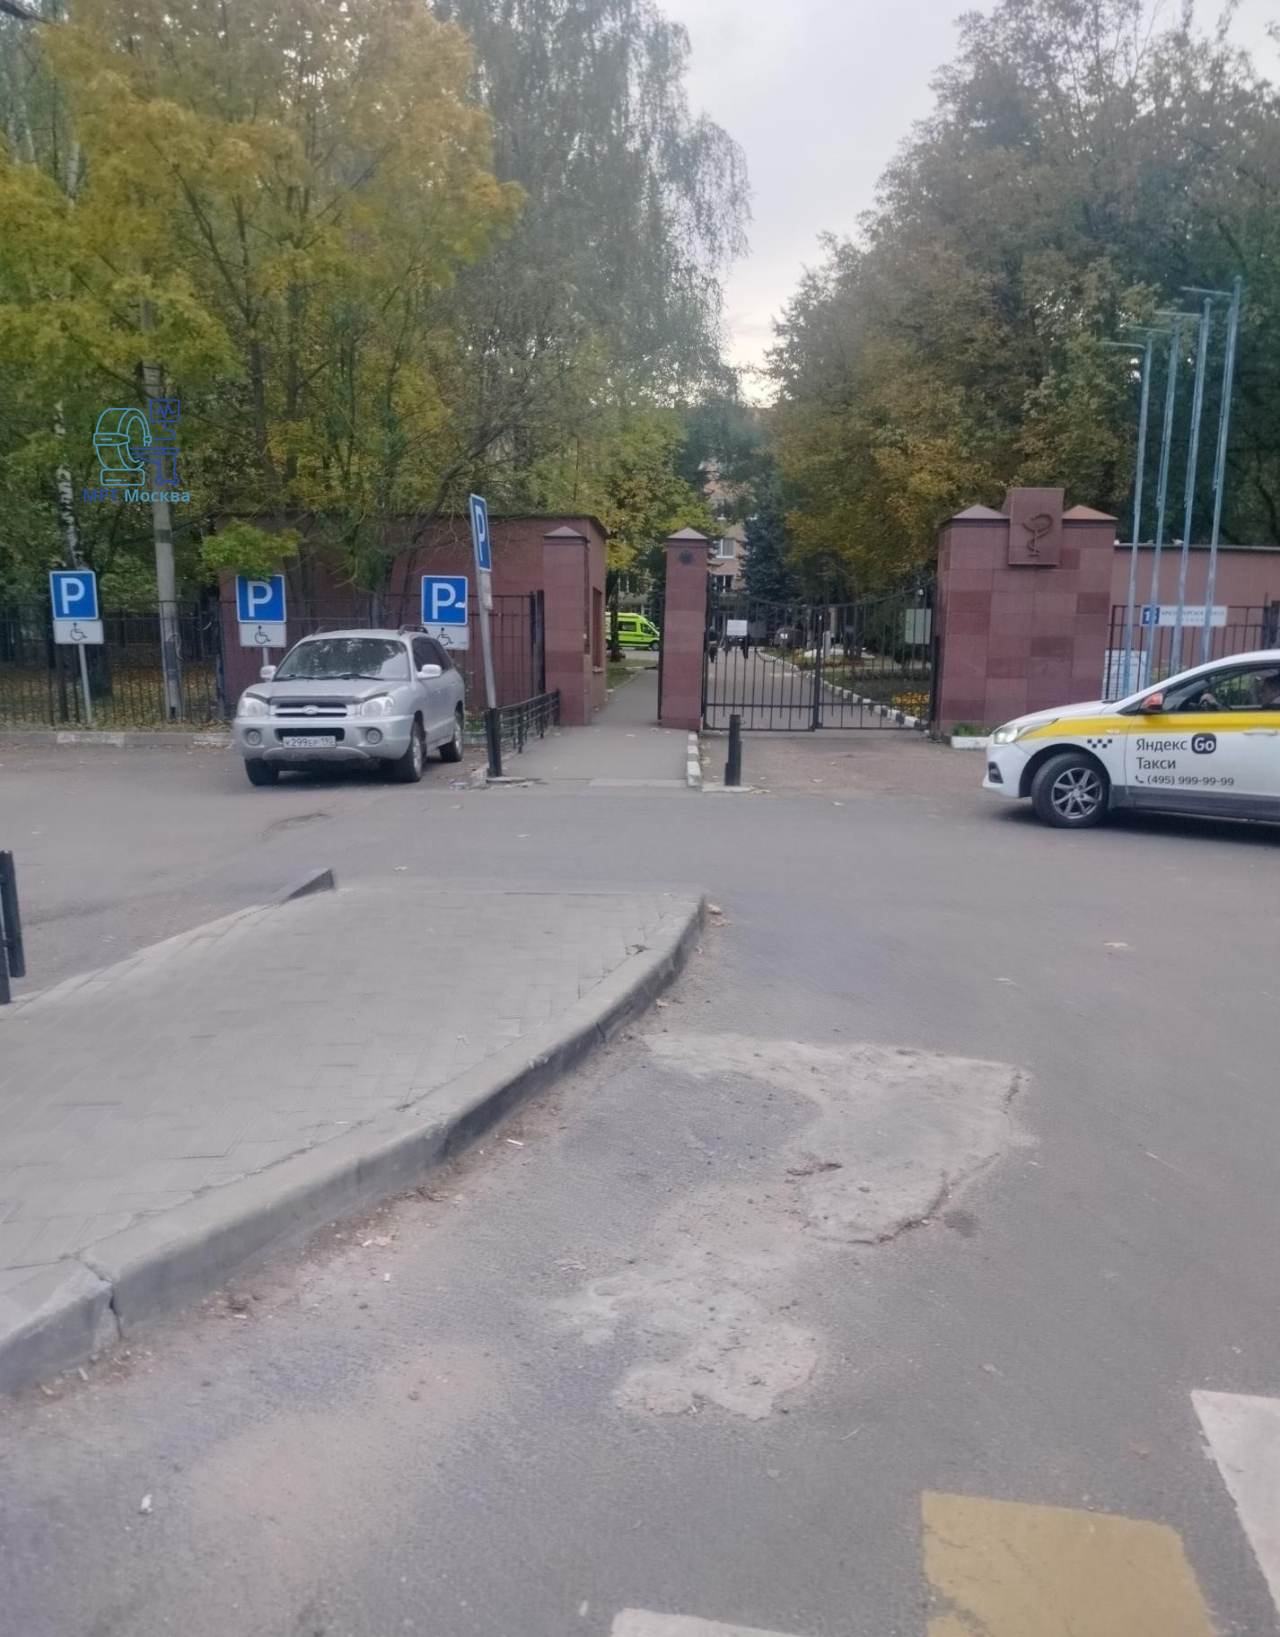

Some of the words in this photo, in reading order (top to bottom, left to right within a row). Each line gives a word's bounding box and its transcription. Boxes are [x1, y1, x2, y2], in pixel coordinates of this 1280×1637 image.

[475, 505, 486, 562] P
[60, 577, 85, 614] P
[247, 580, 273, 617] P
[432, 582, 456, 619] P
[1136, 738, 1187, 752] Яндекс
[1194, 737, 1215, 751] Go
[1136, 757, 1176, 770] Такси
[1147, 775, 1175, 785] (495)
[1178, 776, 1235, 786] 999-99-99
